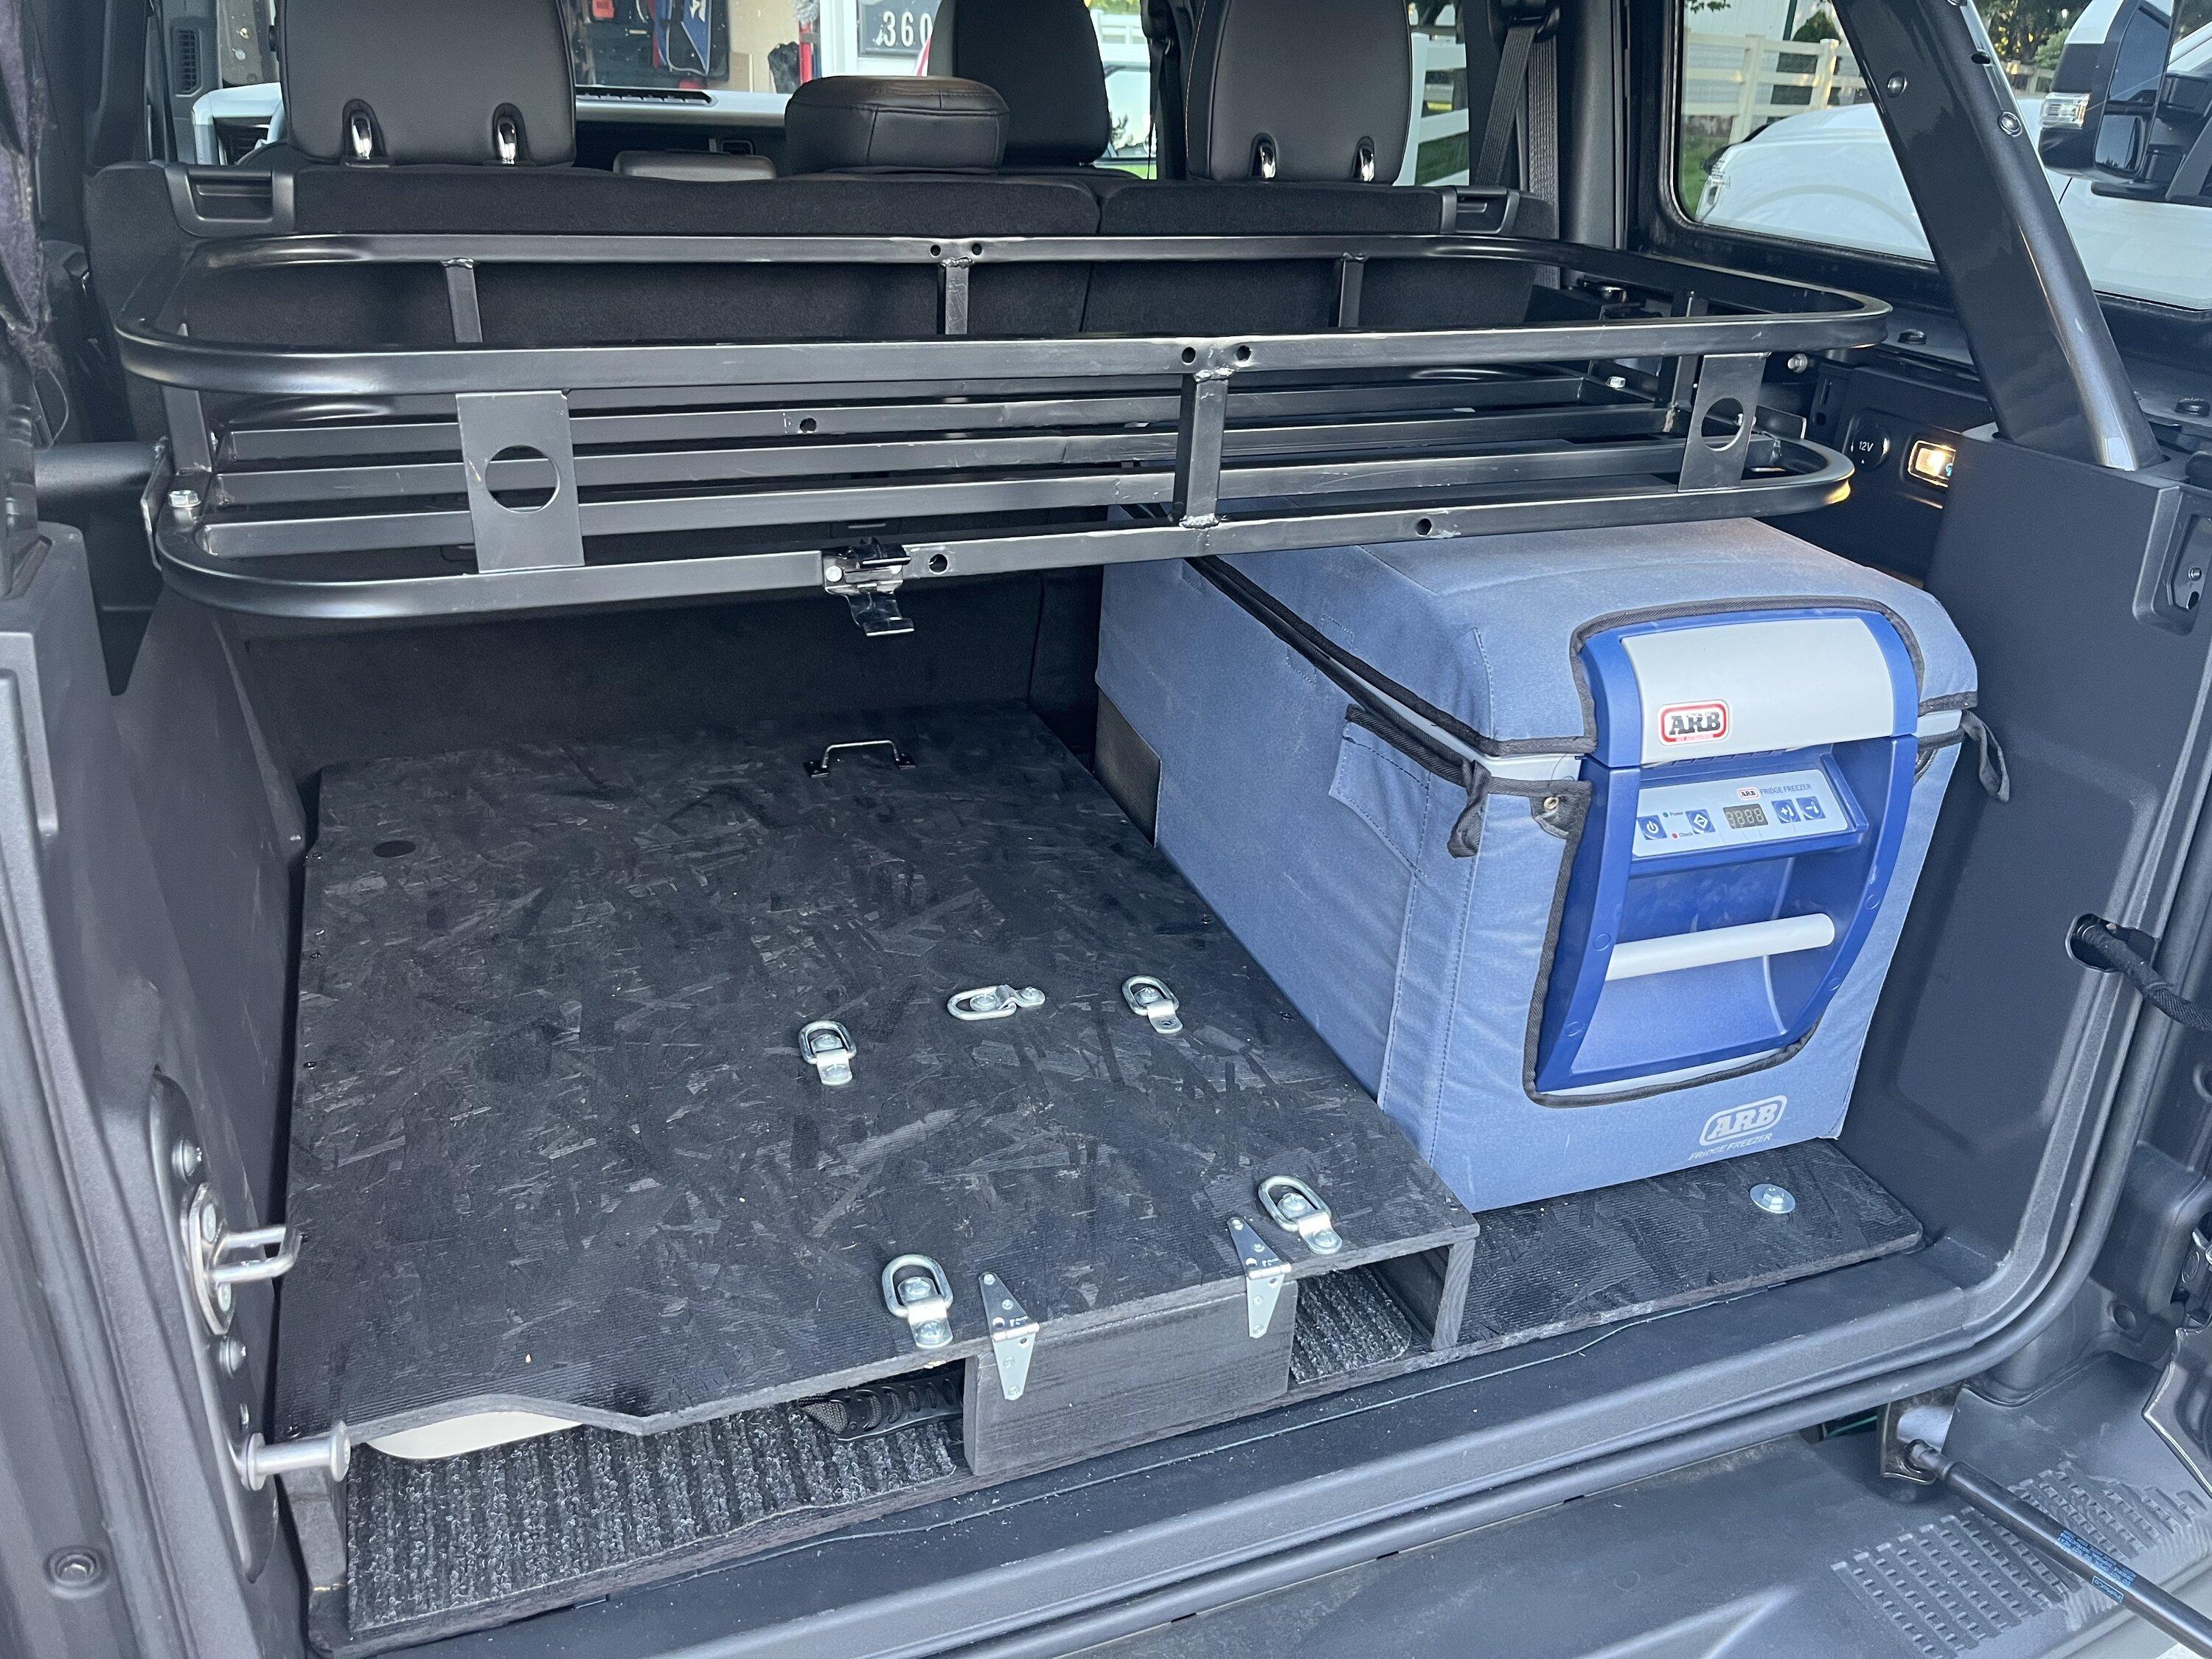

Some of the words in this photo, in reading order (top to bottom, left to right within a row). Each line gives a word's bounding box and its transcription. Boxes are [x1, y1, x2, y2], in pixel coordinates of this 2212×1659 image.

[883, 11, 933, 47] 360
[1858, 440, 1874, 452] 12V
[1669, 711, 1721, 736] ARB
[1760, 787, 1784, 795] FRIDGE
[1784, 783, 1812, 793] FREEZER
[1706, 1103, 1779, 1140] ARB
[1688, 1144, 1727, 1161] FRIDGE
[1727, 1133, 1773, 1151] FREEZER
